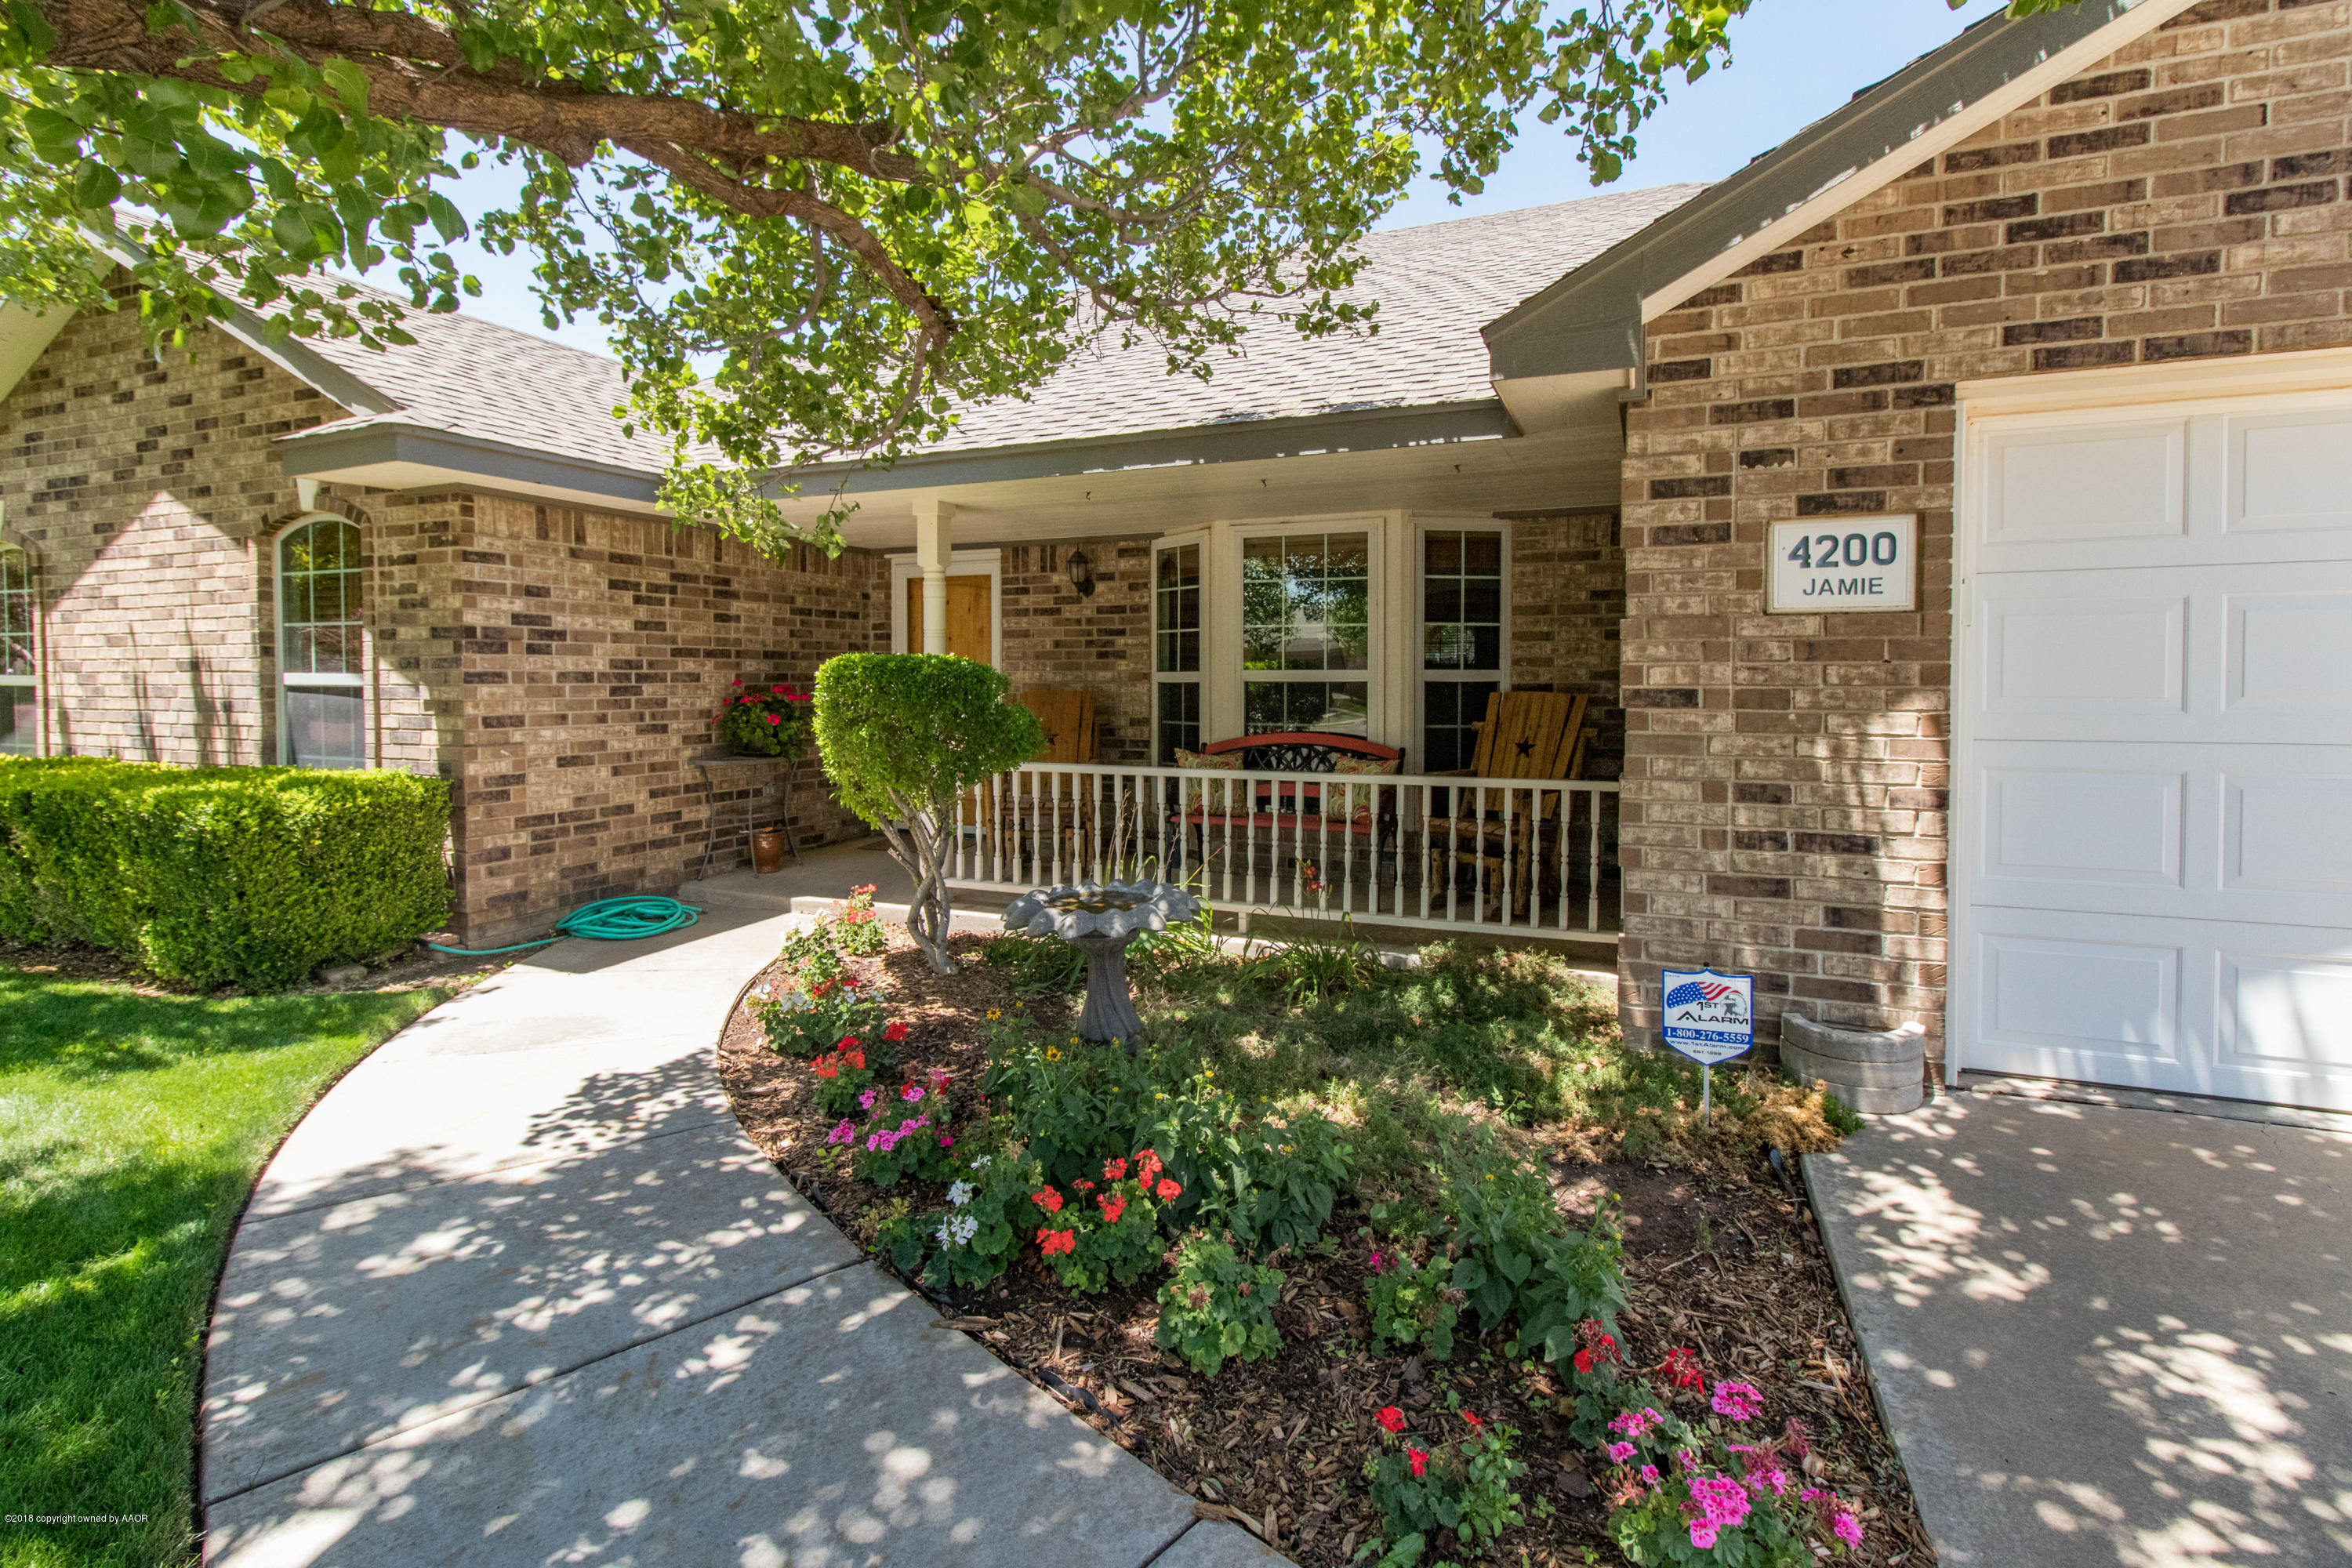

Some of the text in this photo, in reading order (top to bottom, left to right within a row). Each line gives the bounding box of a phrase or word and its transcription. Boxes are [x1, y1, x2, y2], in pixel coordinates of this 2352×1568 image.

[1788, 532, 1896, 568] 4200
[1803, 577, 1883, 596] JAMIE
[1697, 1002, 1719, 1011] 1ST
[1677, 1011, 1749, 1025] ALARM
[1667, 1028, 1749, 1043] 1-800-276-5559
[1670, 1040, 1745, 1051] www.1stAlarm.com
